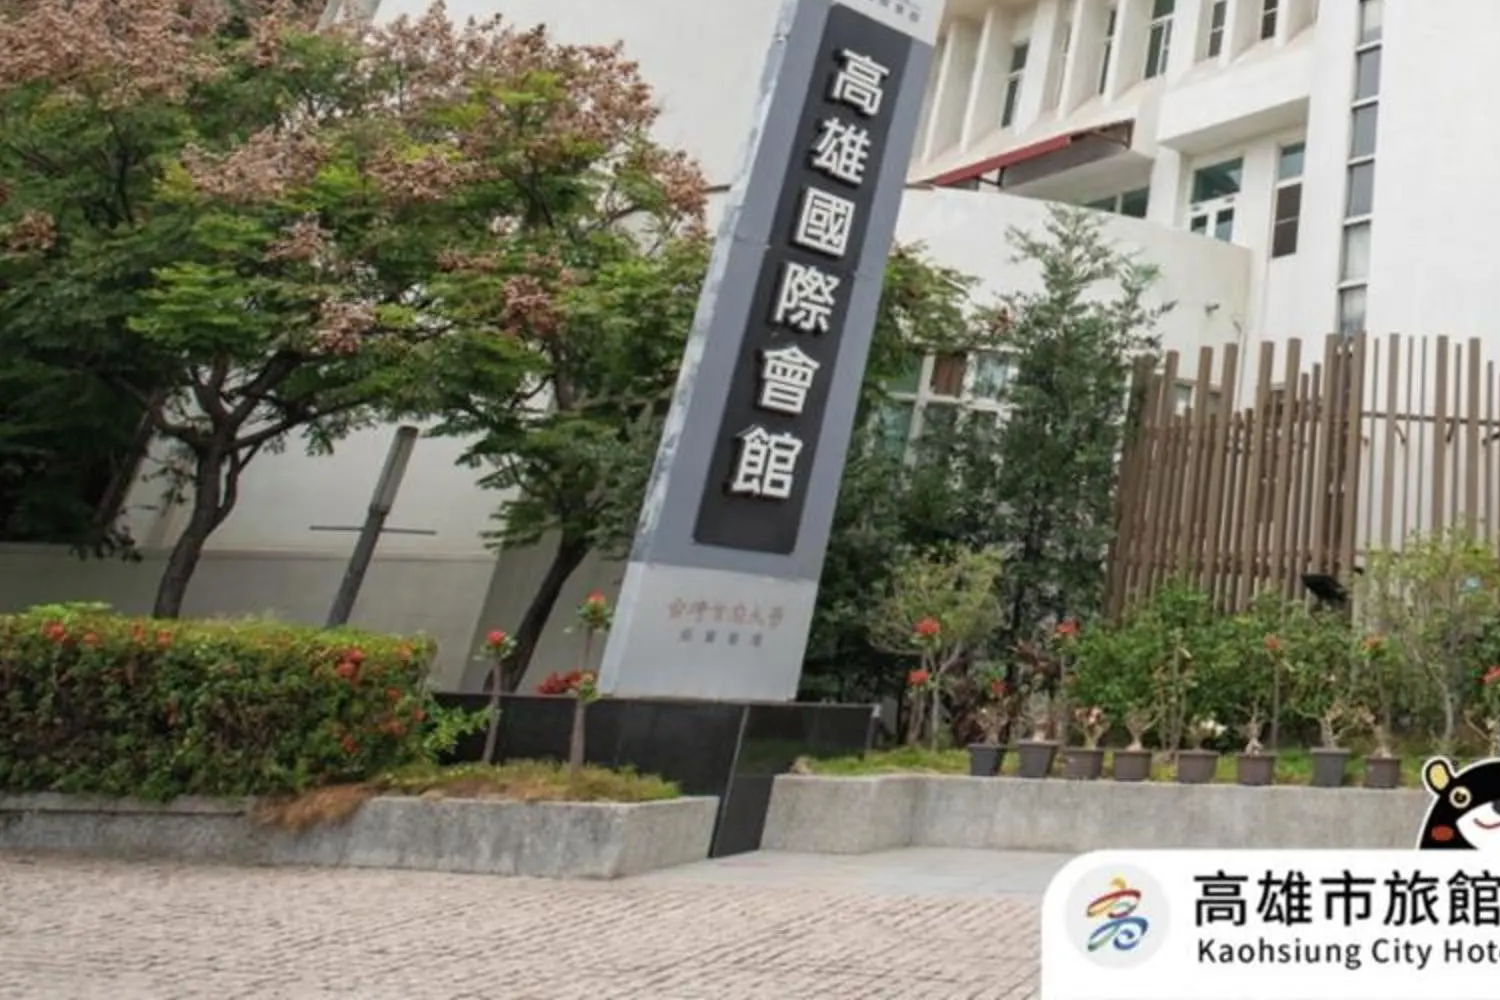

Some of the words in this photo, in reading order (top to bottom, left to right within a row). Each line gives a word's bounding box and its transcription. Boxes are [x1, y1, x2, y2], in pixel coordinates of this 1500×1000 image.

[731, 48, 891, 499] 高雄國際會館
